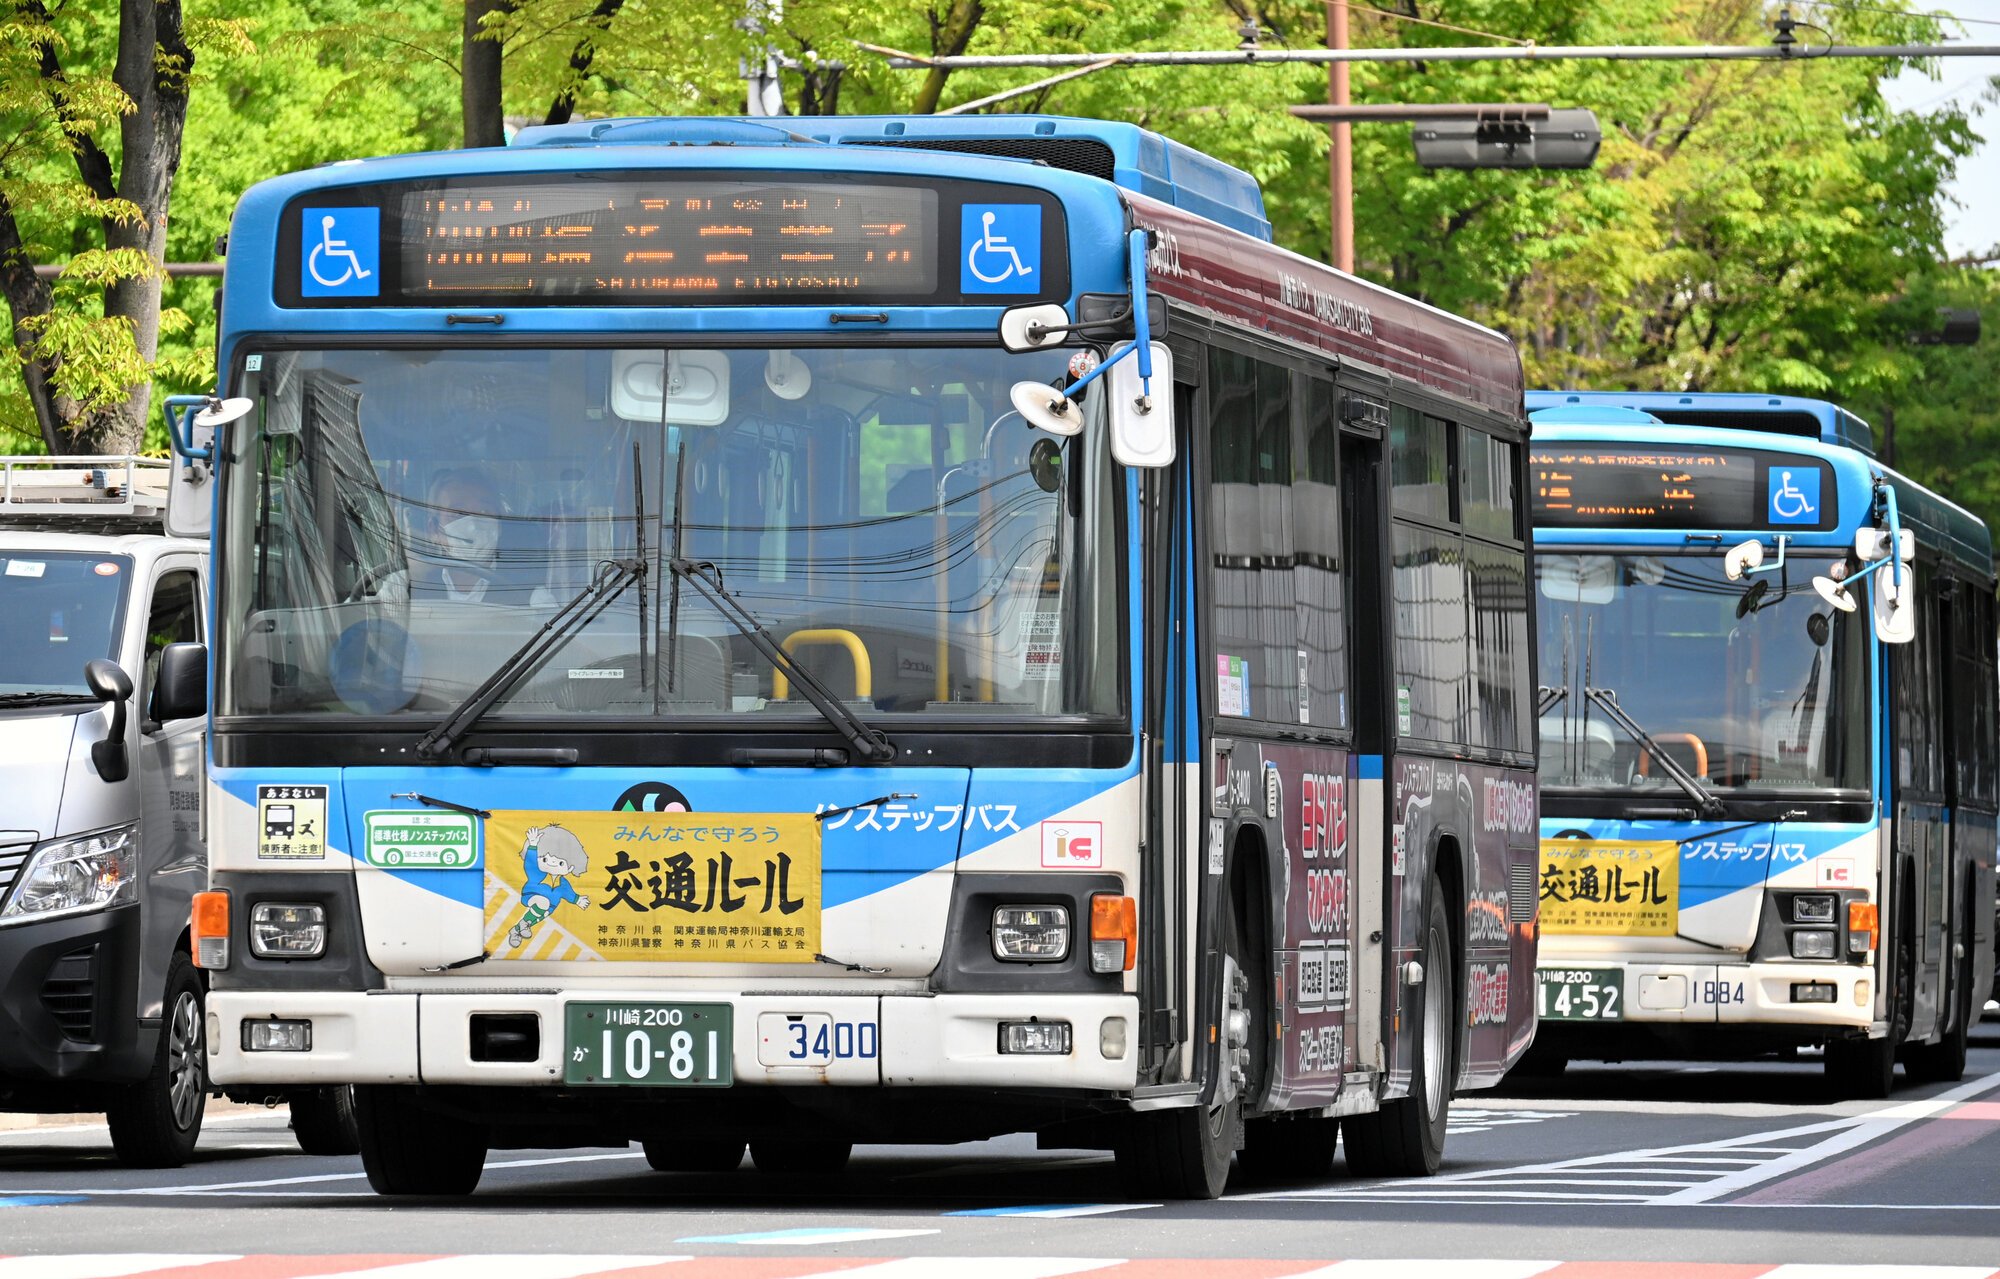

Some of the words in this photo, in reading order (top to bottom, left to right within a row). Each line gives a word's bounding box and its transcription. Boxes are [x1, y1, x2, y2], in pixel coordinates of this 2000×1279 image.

[266, 787, 316, 799] あぶない
[412, 816, 431, 824] 認定
[1302, 773, 1347, 859] ヨドバシ
[373, 829, 469, 842] 標準仕様ノンステップバス
[613, 824, 781, 843] みんなで守ろう
[260, 843, 322, 855] 横断者に注意!
[404, 850, 439, 858] 国土交通省
[1546, 847, 1653, 861] みんなで守ろう
[599, 850, 805, 915] 交通ルール
[1539, 863, 1668, 905] 交通ルール
[597, 925, 663, 936] 神奈川県
[673, 925, 806, 937] 関東運輸局神奈川運輸支局
[597, 938, 663, 949] 神奈川県警察
[673, 938, 806, 950] 神奈川県バス協会
[1692, 980, 1745, 1004] 1884
[1538, 983, 1619, 1018] 14-52
[788, 1022, 877, 1059] 3400
[572, 1046, 589, 1062] か
[602, 1029, 718, 1080] 10-81
